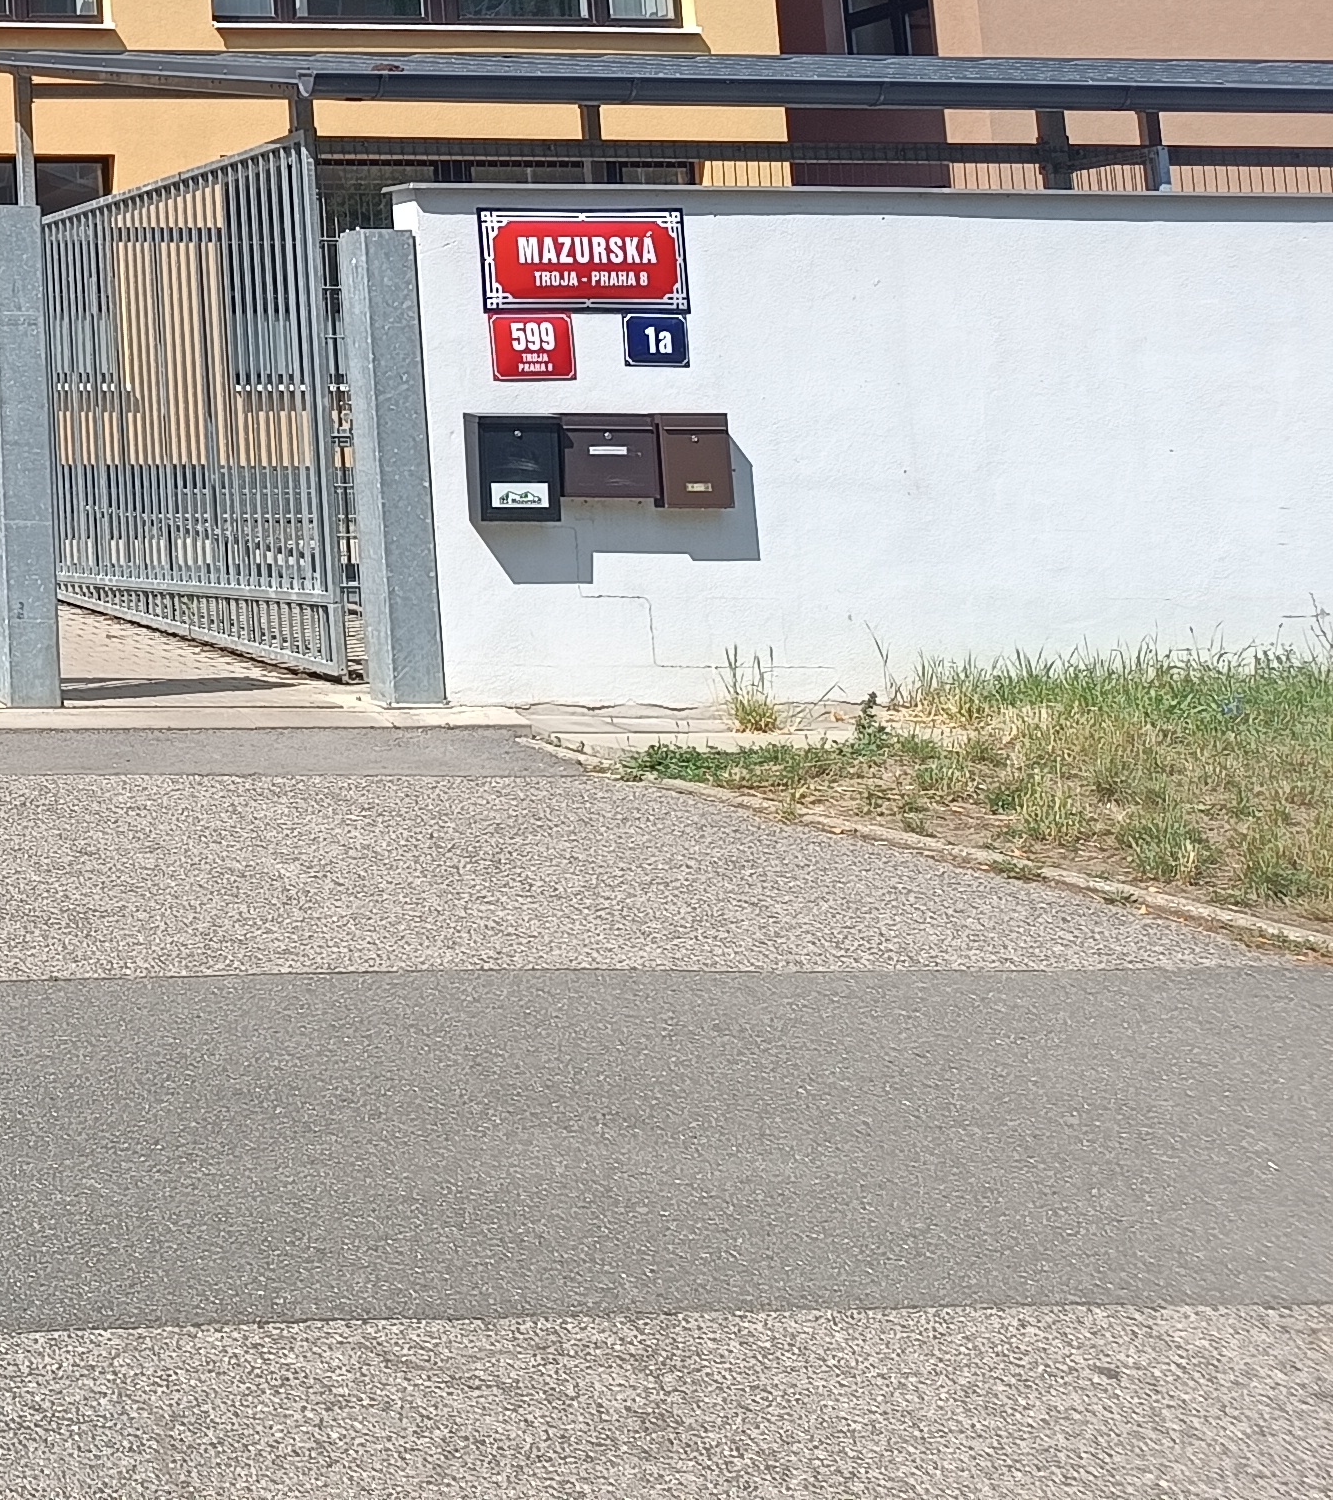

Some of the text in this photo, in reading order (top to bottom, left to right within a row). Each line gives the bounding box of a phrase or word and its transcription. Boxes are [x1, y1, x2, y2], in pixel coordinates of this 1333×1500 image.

[517, 231, 658, 264] MAZURSKÁ
[534, 271, 578, 288] TROJA
[591, 271, 637, 286] PRAHA
[640, 271, 648, 286] 8
[510, 321, 555, 351] 599
[644, 326, 673, 354] 1a
[518, 363, 546, 372] PRAHA
[521, 353, 549, 362] TROJA
